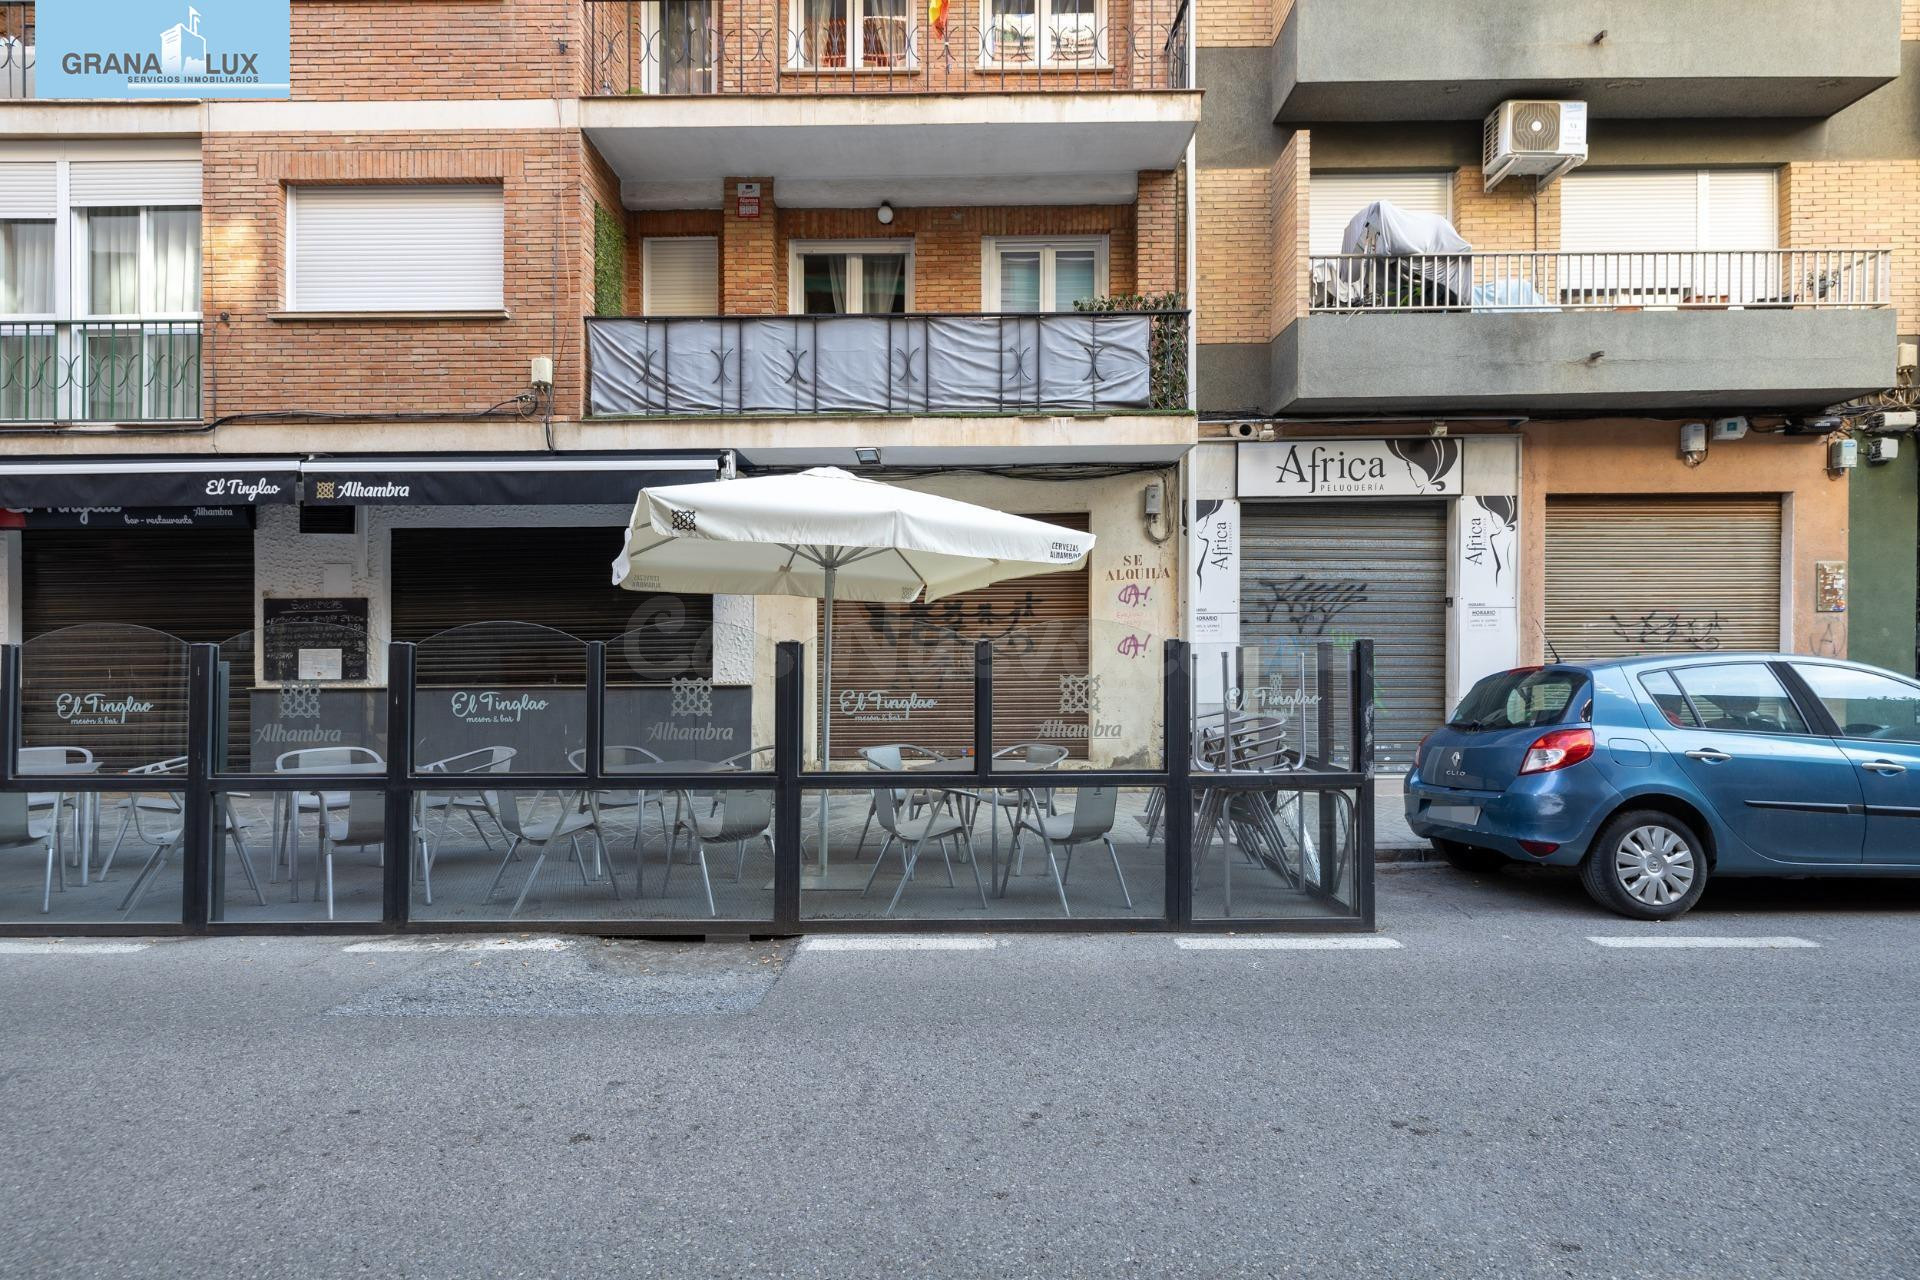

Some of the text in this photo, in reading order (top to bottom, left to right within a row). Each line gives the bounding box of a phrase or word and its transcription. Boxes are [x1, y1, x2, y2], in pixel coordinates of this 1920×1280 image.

[1275, 444, 1387, 493] Africa
[205, 477, 281, 501] El Tinglao
[336, 481, 410, 498] Alhambra
[1320, 483, 1385, 492] PELUQUERÍA
[193, 507, 233, 517] Alhambra
[1051, 542, 1079, 552] CERVEZAS
[1210, 521, 1233, 570] Africa
[1465, 518, 1488, 565] Africa
[1123, 554, 1143, 566] SE
[1105, 567, 1171, 581] ALQUILA
[56, 692, 155, 724] El Tinglao
[451, 691, 550, 722] El Tinglao
[839, 689, 867, 716] El
[254, 723, 342, 744] Alhambra
[646, 721, 734, 742] Alhambra
[1034, 719, 1122, 741] Alhambra
